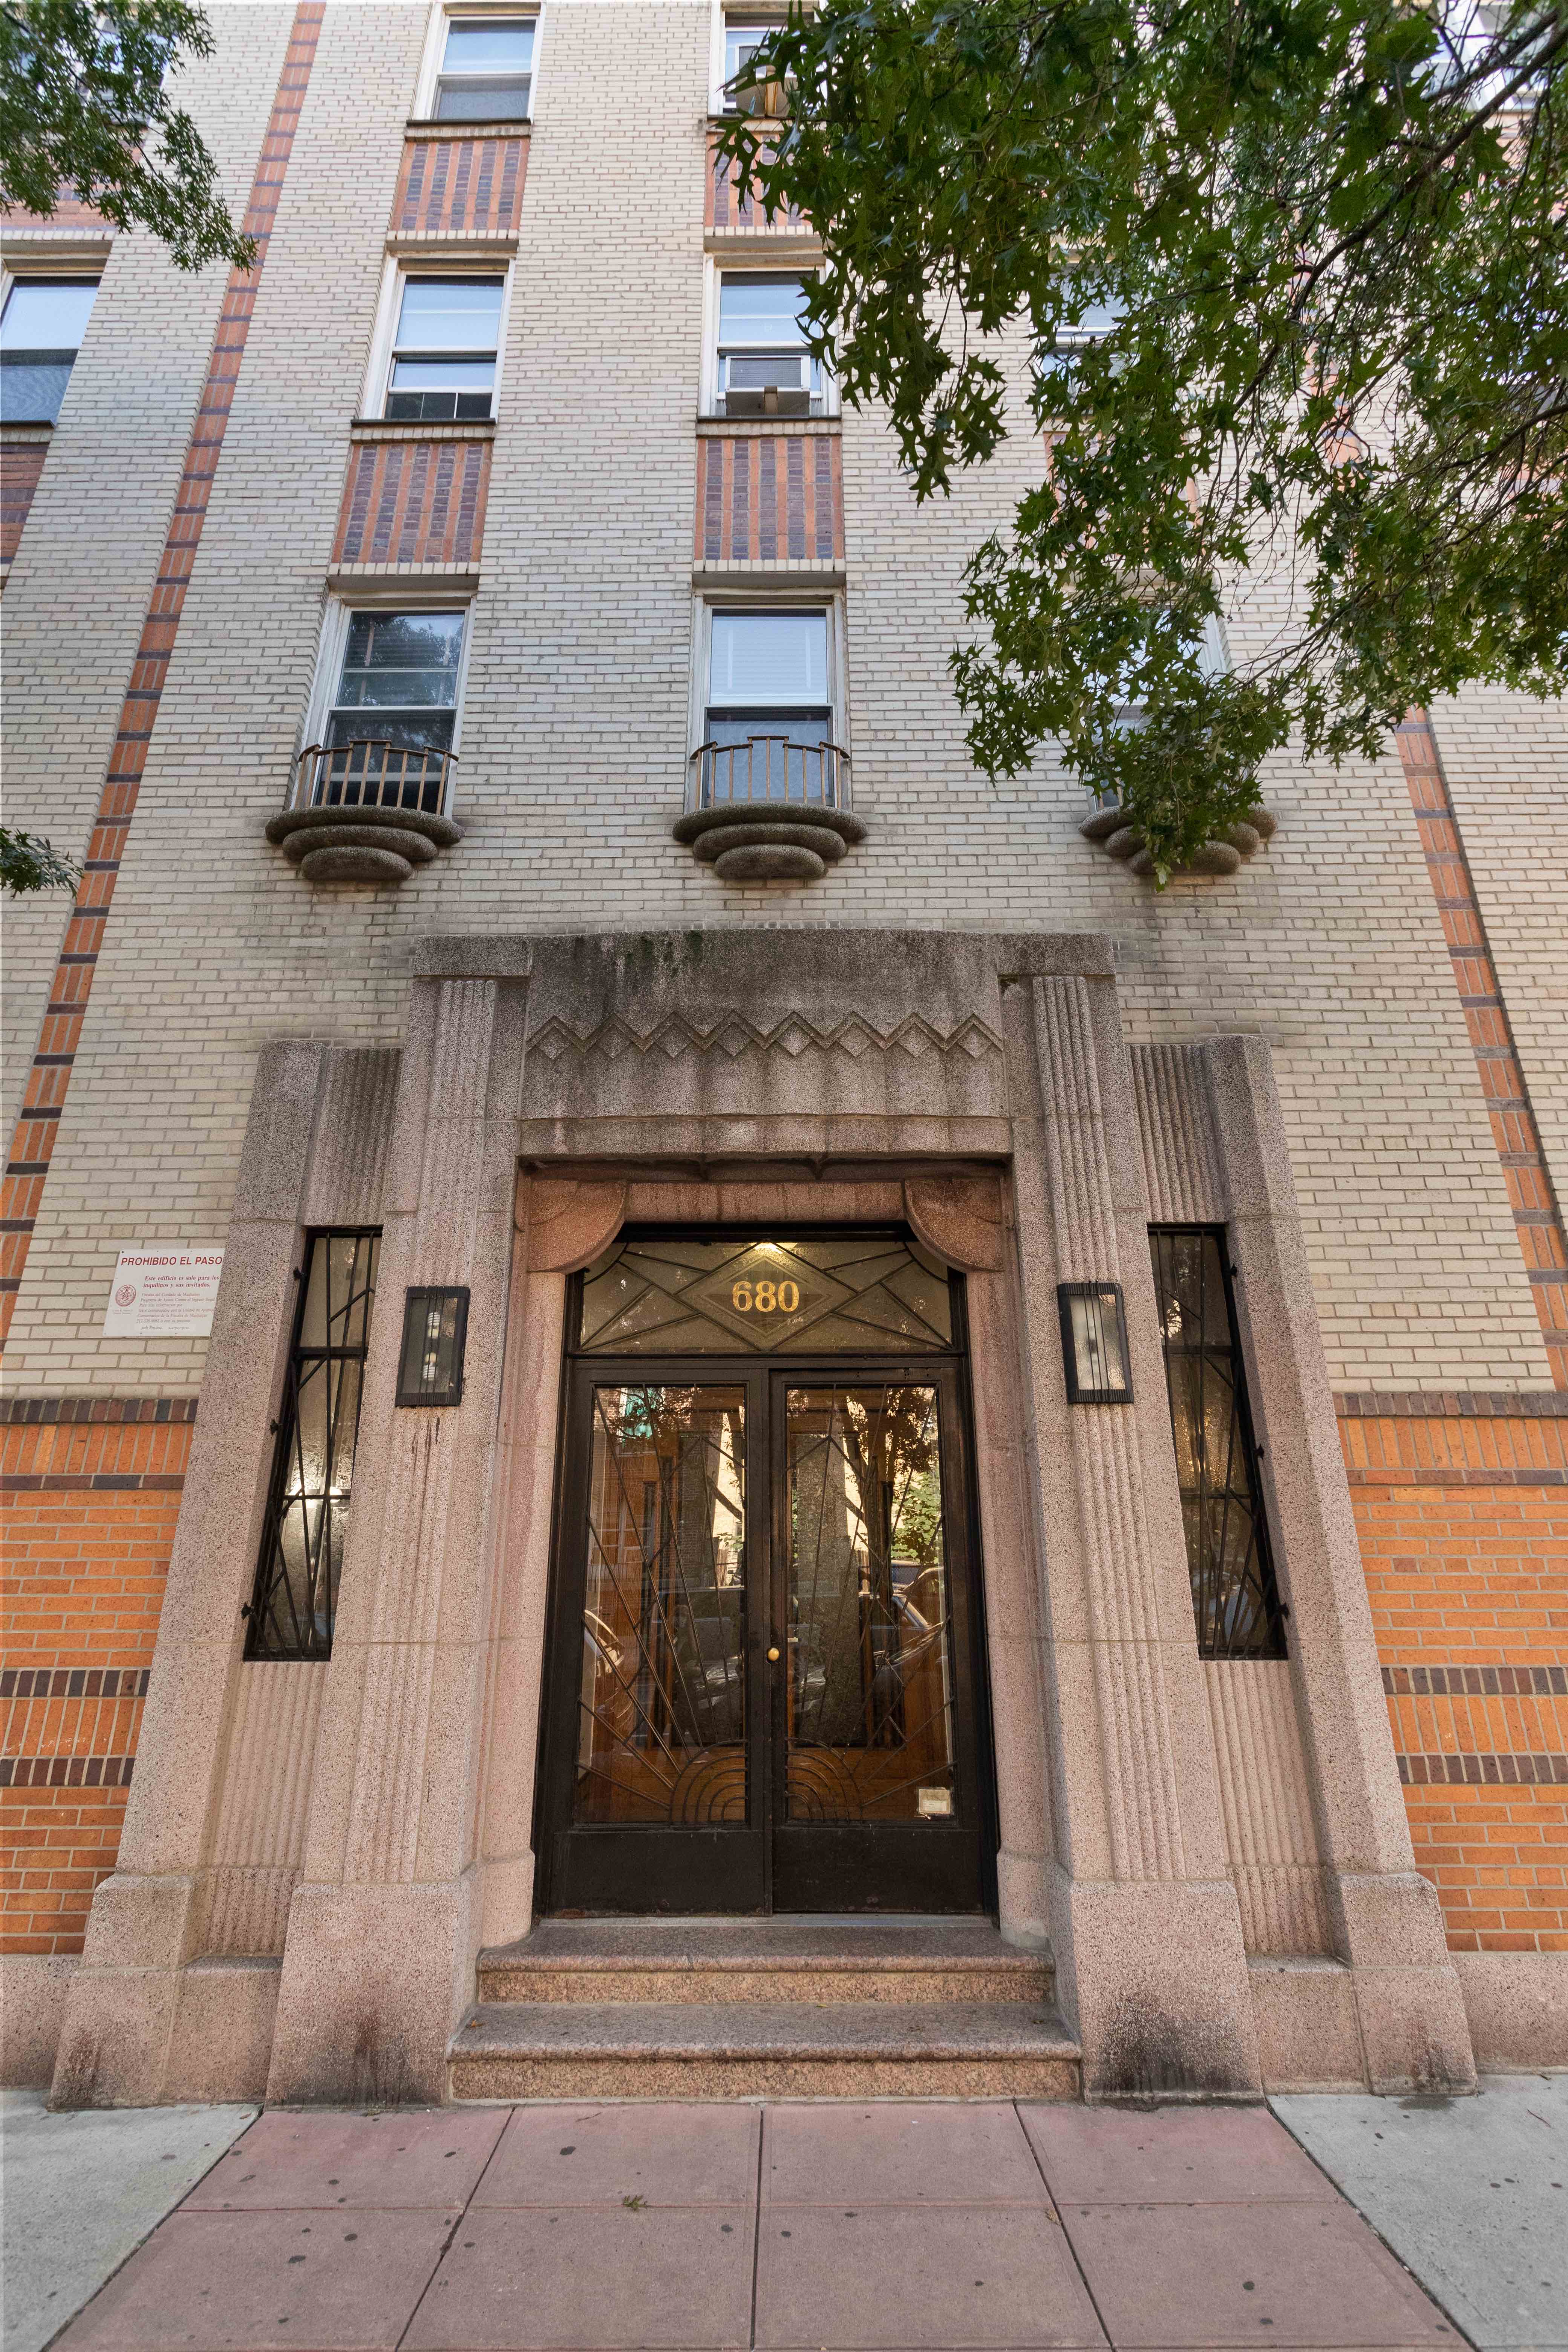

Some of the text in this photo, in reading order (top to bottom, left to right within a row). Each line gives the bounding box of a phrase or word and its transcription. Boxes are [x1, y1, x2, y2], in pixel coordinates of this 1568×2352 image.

[121, 1257, 222, 1265] PROHIBIDO EL PASO
[732, 1281, 799, 1312] 680
